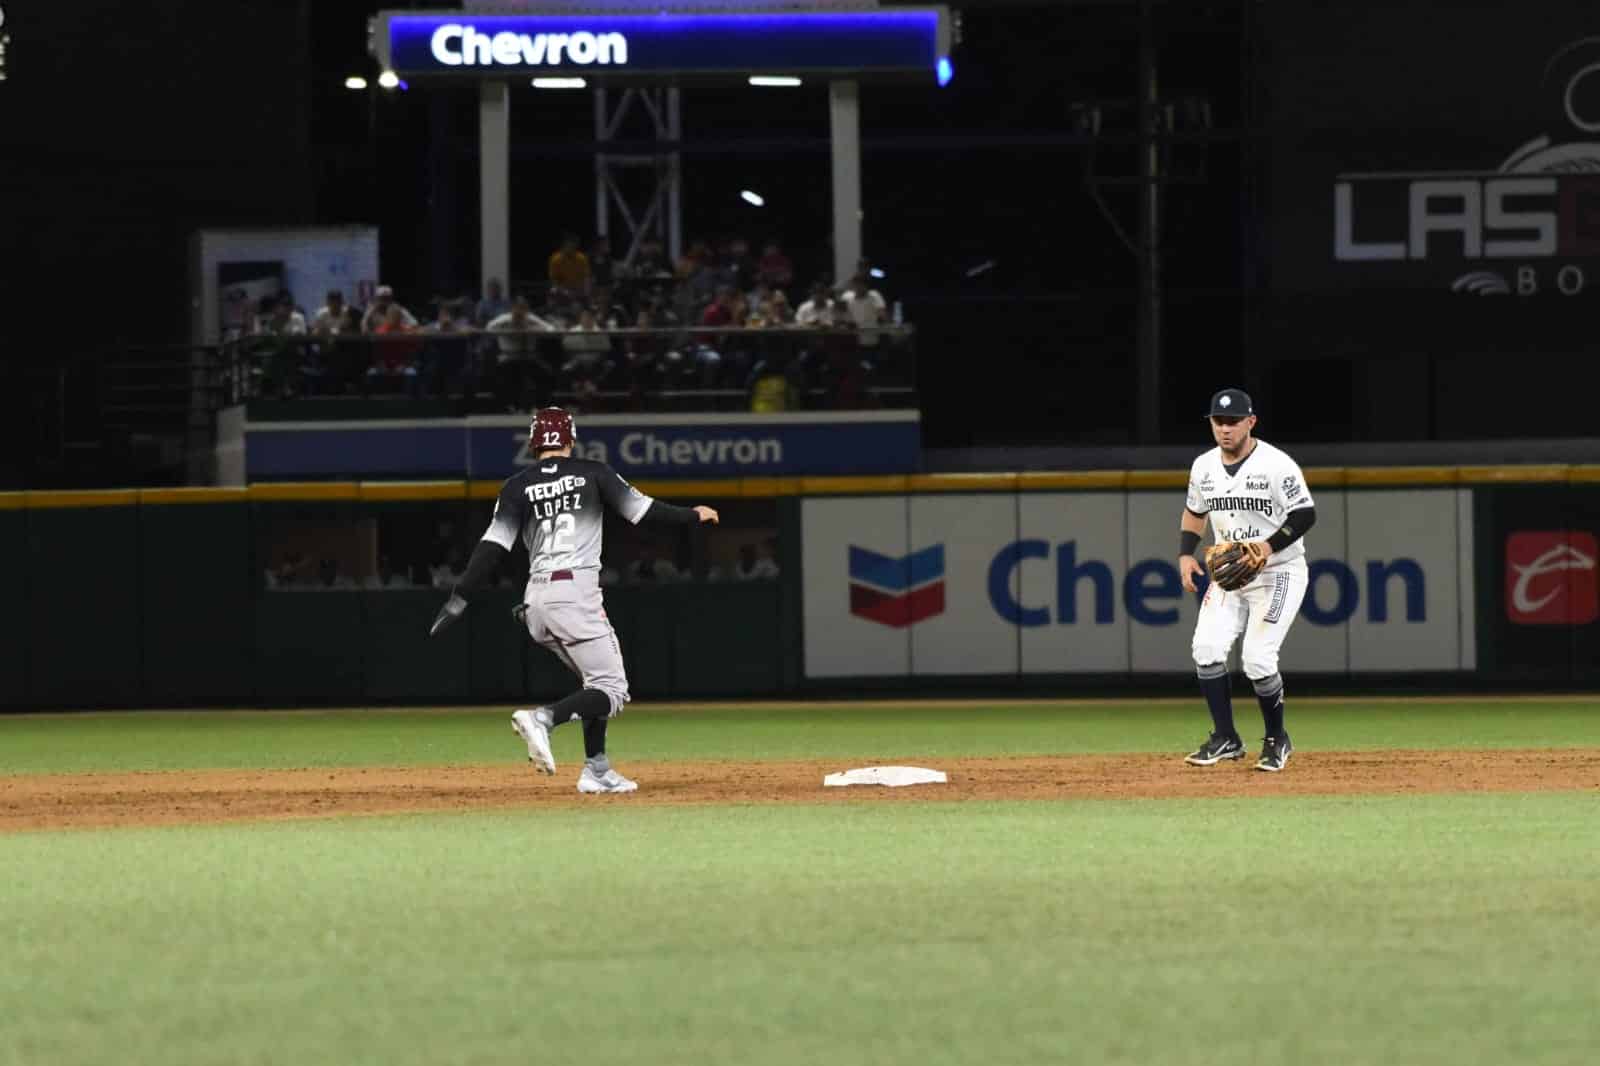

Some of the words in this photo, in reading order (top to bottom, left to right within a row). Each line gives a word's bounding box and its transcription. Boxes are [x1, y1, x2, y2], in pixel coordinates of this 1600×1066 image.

[431, 24, 628, 65] Chevron
[512, 435, 608, 464] Zna
[620, 434, 783, 464] Chevron
[542, 432, 562, 446] 12
[525, 475, 575, 502] TECATE
[534, 494, 582, 520] LOPEZ
[541, 513, 575, 554] 12
[987, 538, 1426, 627] Cheon
